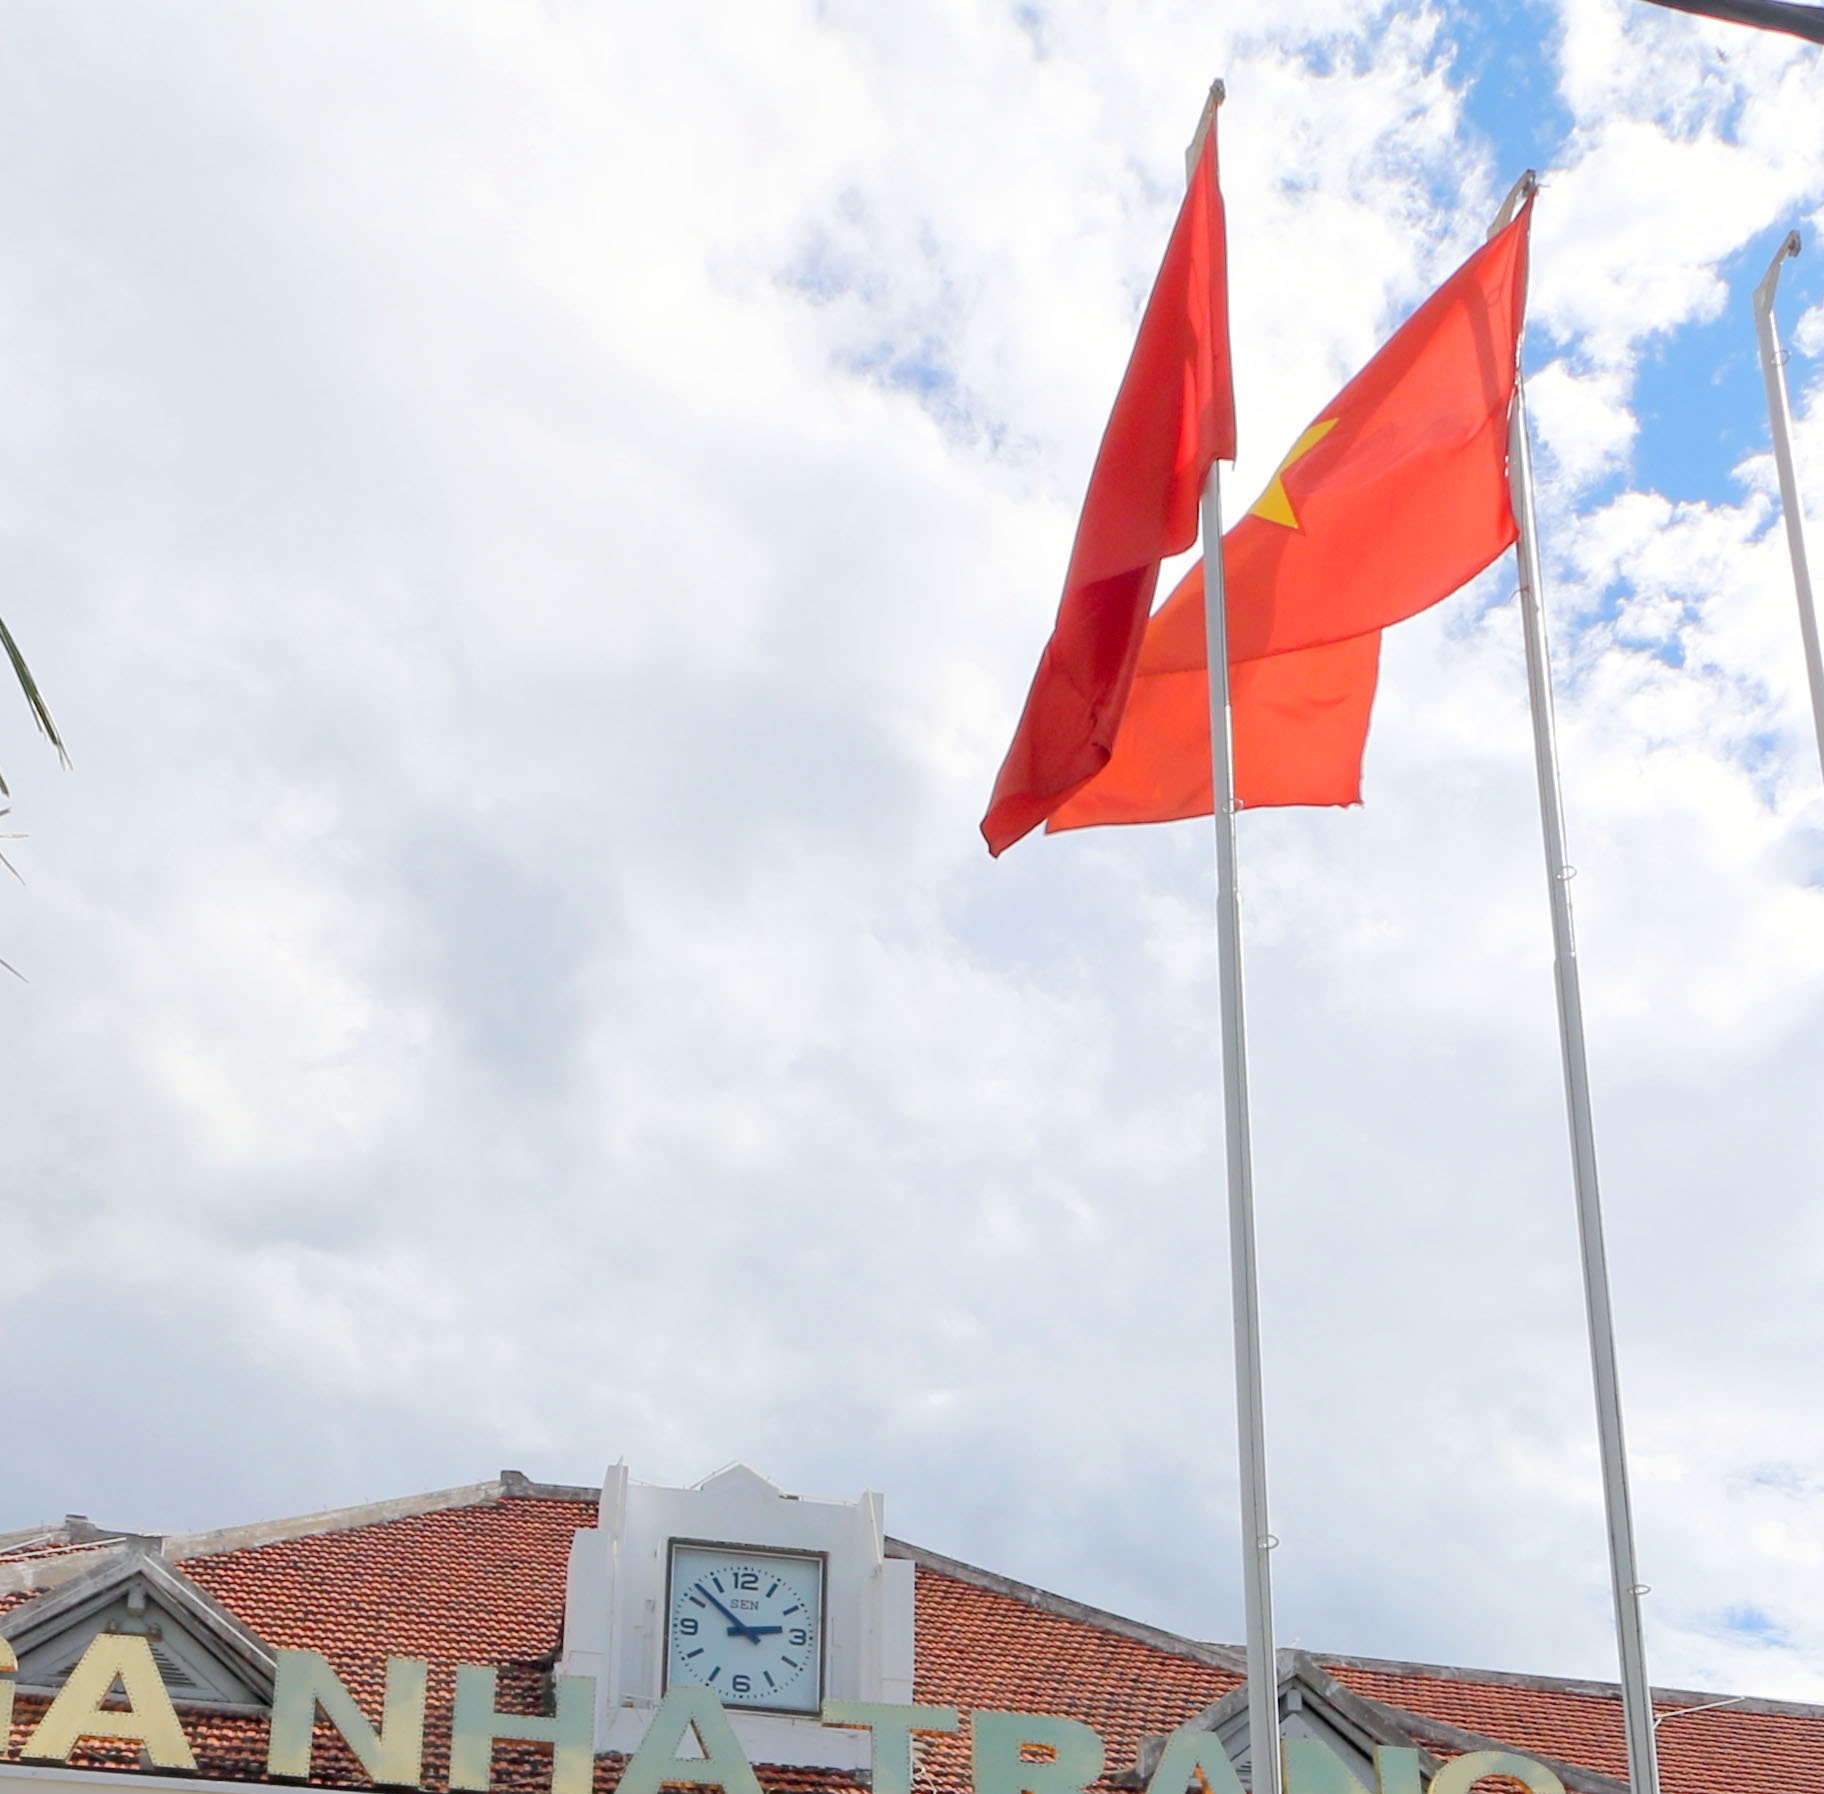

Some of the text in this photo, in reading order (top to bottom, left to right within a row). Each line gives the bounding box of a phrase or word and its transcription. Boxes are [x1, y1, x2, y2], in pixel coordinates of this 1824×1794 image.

[732, 1571, 760, 1592] 12
[729, 1598, 760, 1611] SEN
[679, 1617, 699, 1636] 9
[788, 1627, 808, 1647] 3
[731, 1674, 752, 1694] 6
